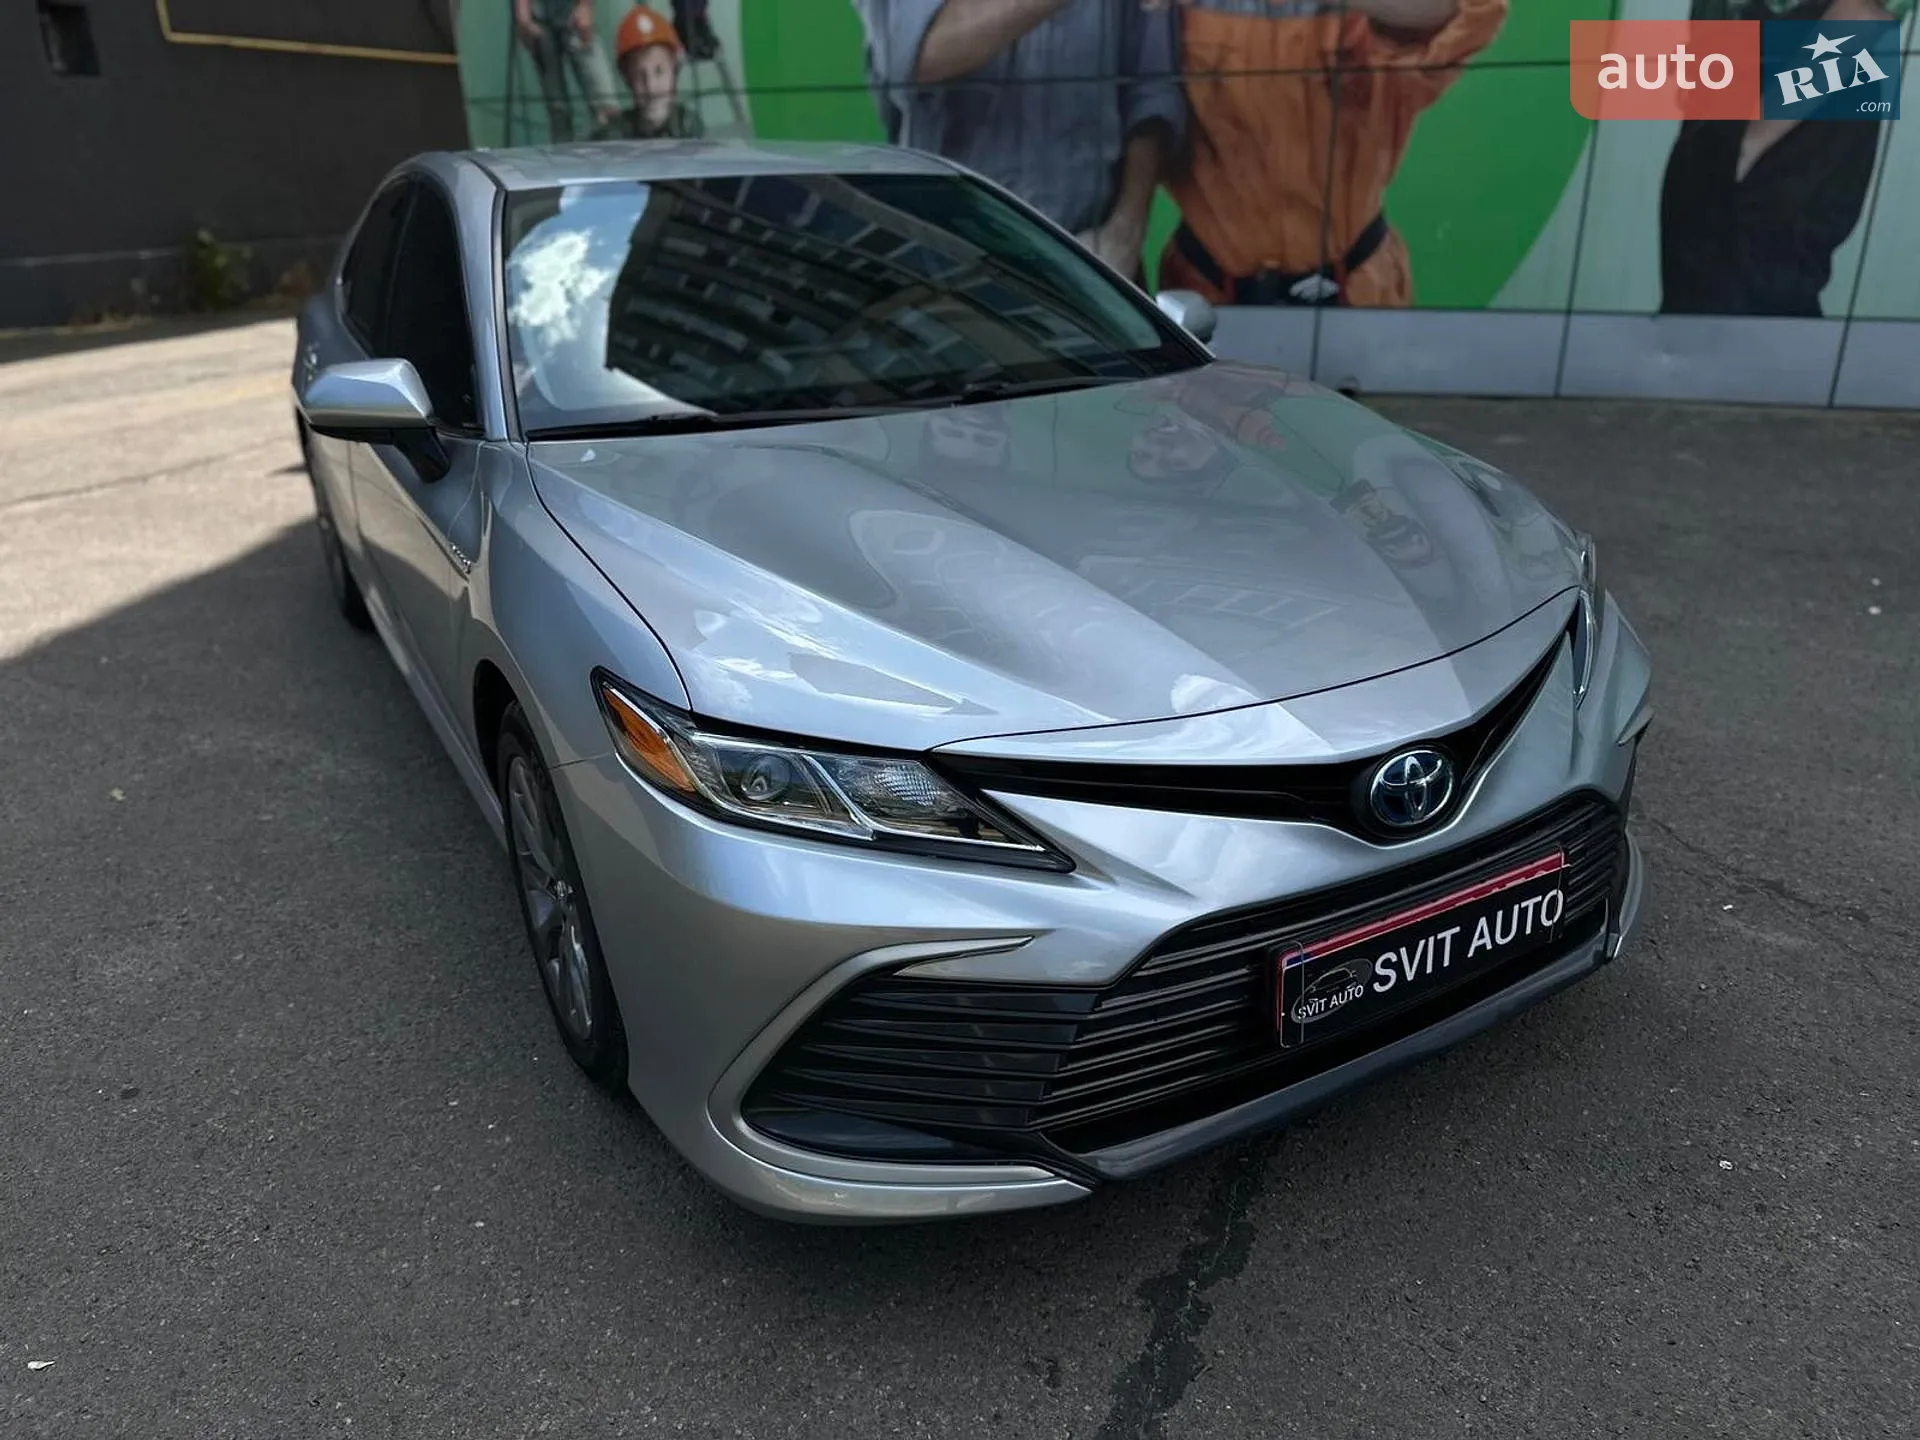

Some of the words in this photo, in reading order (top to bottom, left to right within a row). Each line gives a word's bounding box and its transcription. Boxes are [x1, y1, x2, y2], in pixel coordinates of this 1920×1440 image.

[1372, 926, 1461, 993] SVIT
[1467, 889, 1564, 958] AUTO
[1297, 998, 1327, 1020] SVIT
[1329, 983, 1364, 1008] AUTO
